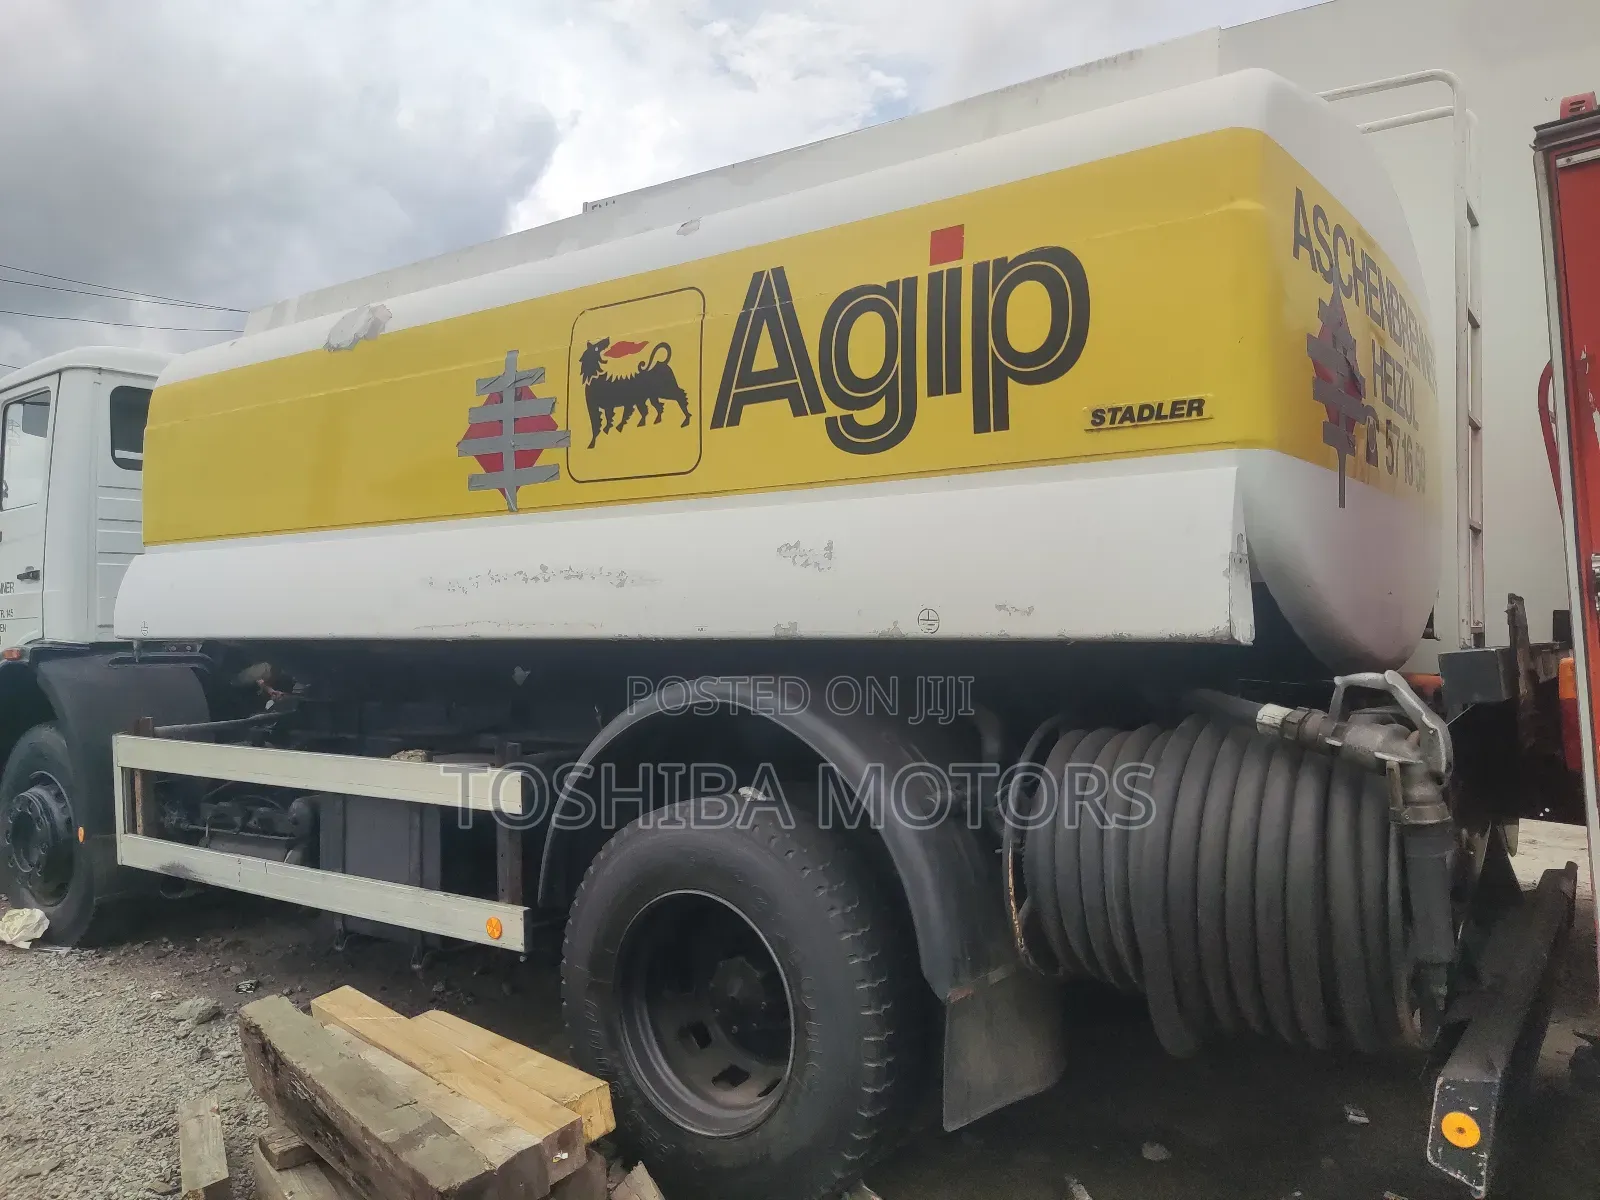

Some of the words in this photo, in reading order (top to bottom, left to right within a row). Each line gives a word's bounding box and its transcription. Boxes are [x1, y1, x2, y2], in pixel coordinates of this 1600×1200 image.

[710, 224, 1090, 455] Agip
[1090, 398, 1206, 427] STADLER
[1371, 338, 1419, 431] HEIZÖL
[1385, 419, 1400, 478] 57
